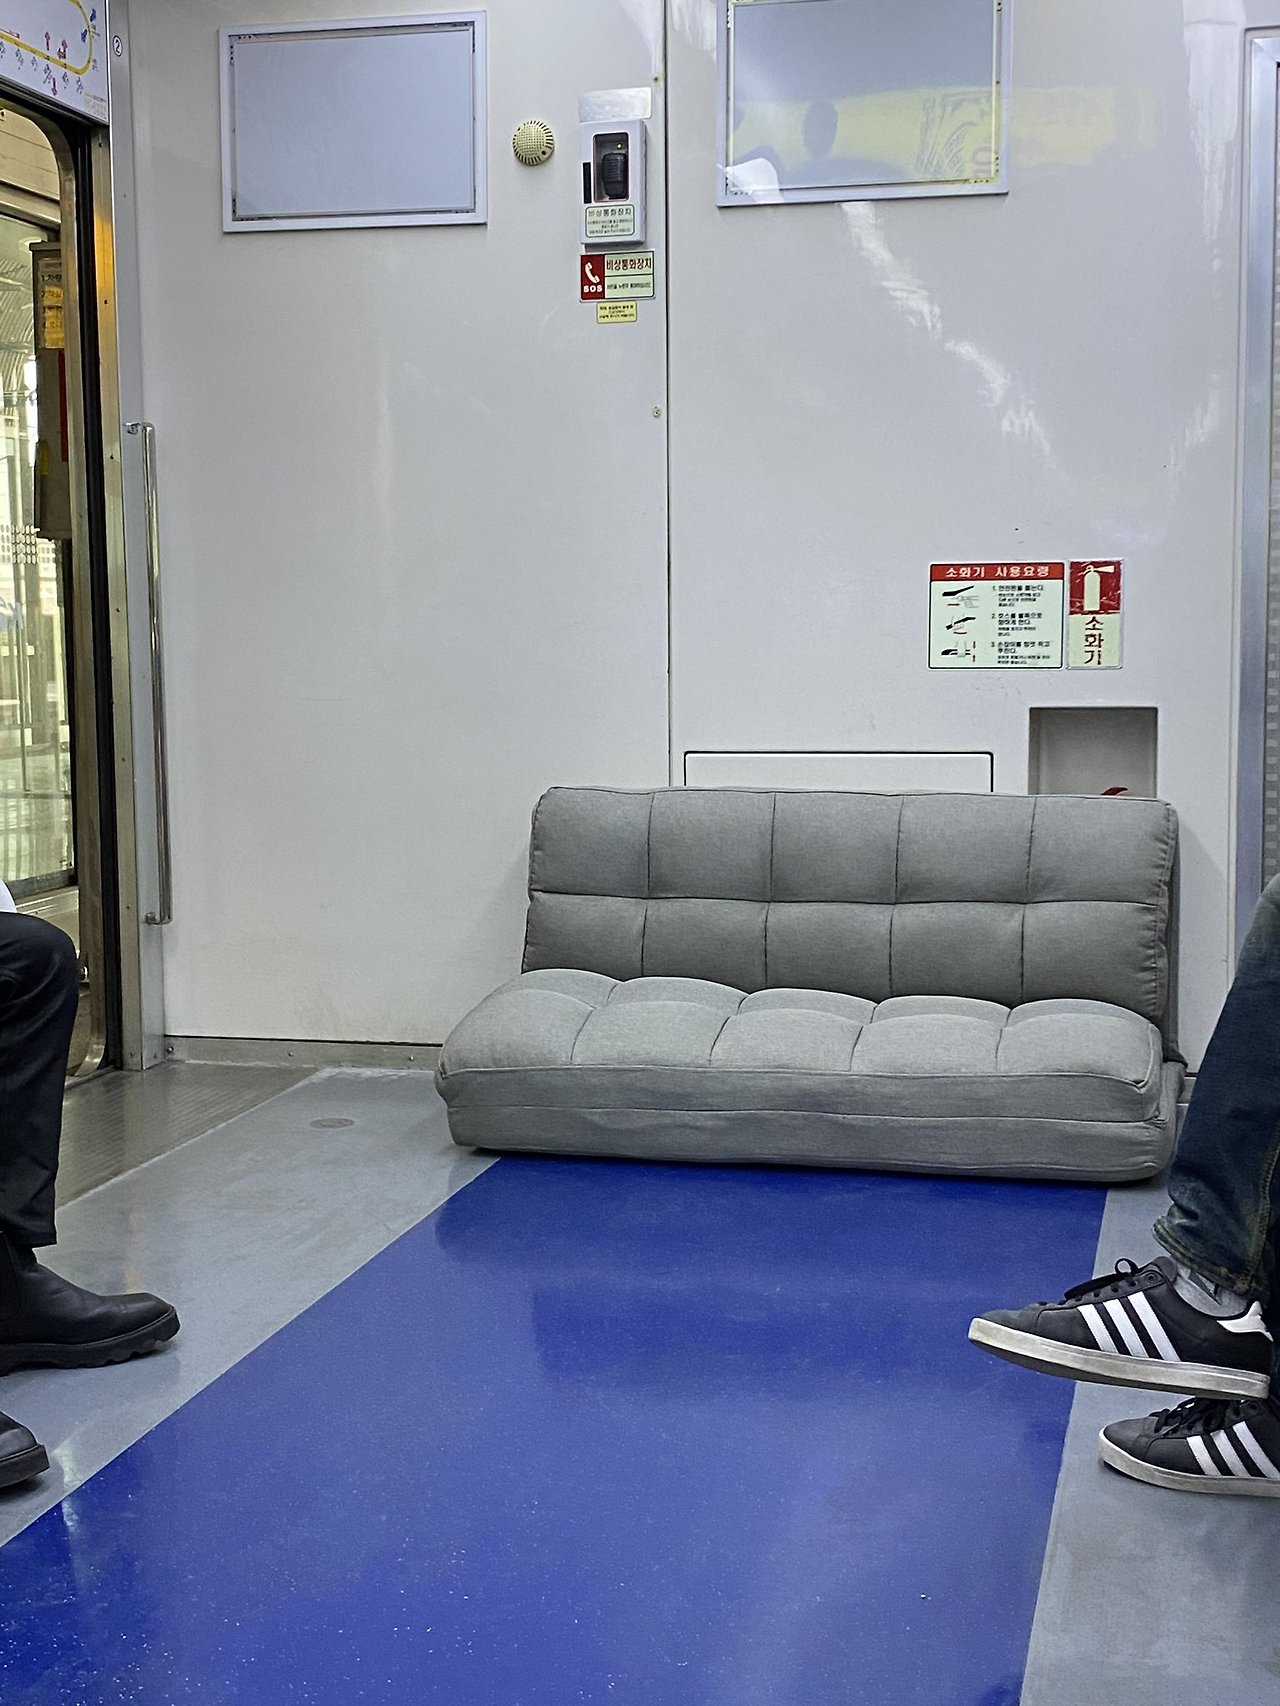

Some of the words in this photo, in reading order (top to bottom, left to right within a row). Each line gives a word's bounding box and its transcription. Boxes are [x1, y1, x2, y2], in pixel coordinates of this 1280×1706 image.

[588, 208, 632, 217] 비상통화장치
[606, 257, 652, 272] 비상통화장치
[583, 284, 603, 293] SOS
[945, 566, 985, 578] 소화기
[994, 565, 1050, 578] 사용요령
[1084, 615, 1104, 666] 소화기
